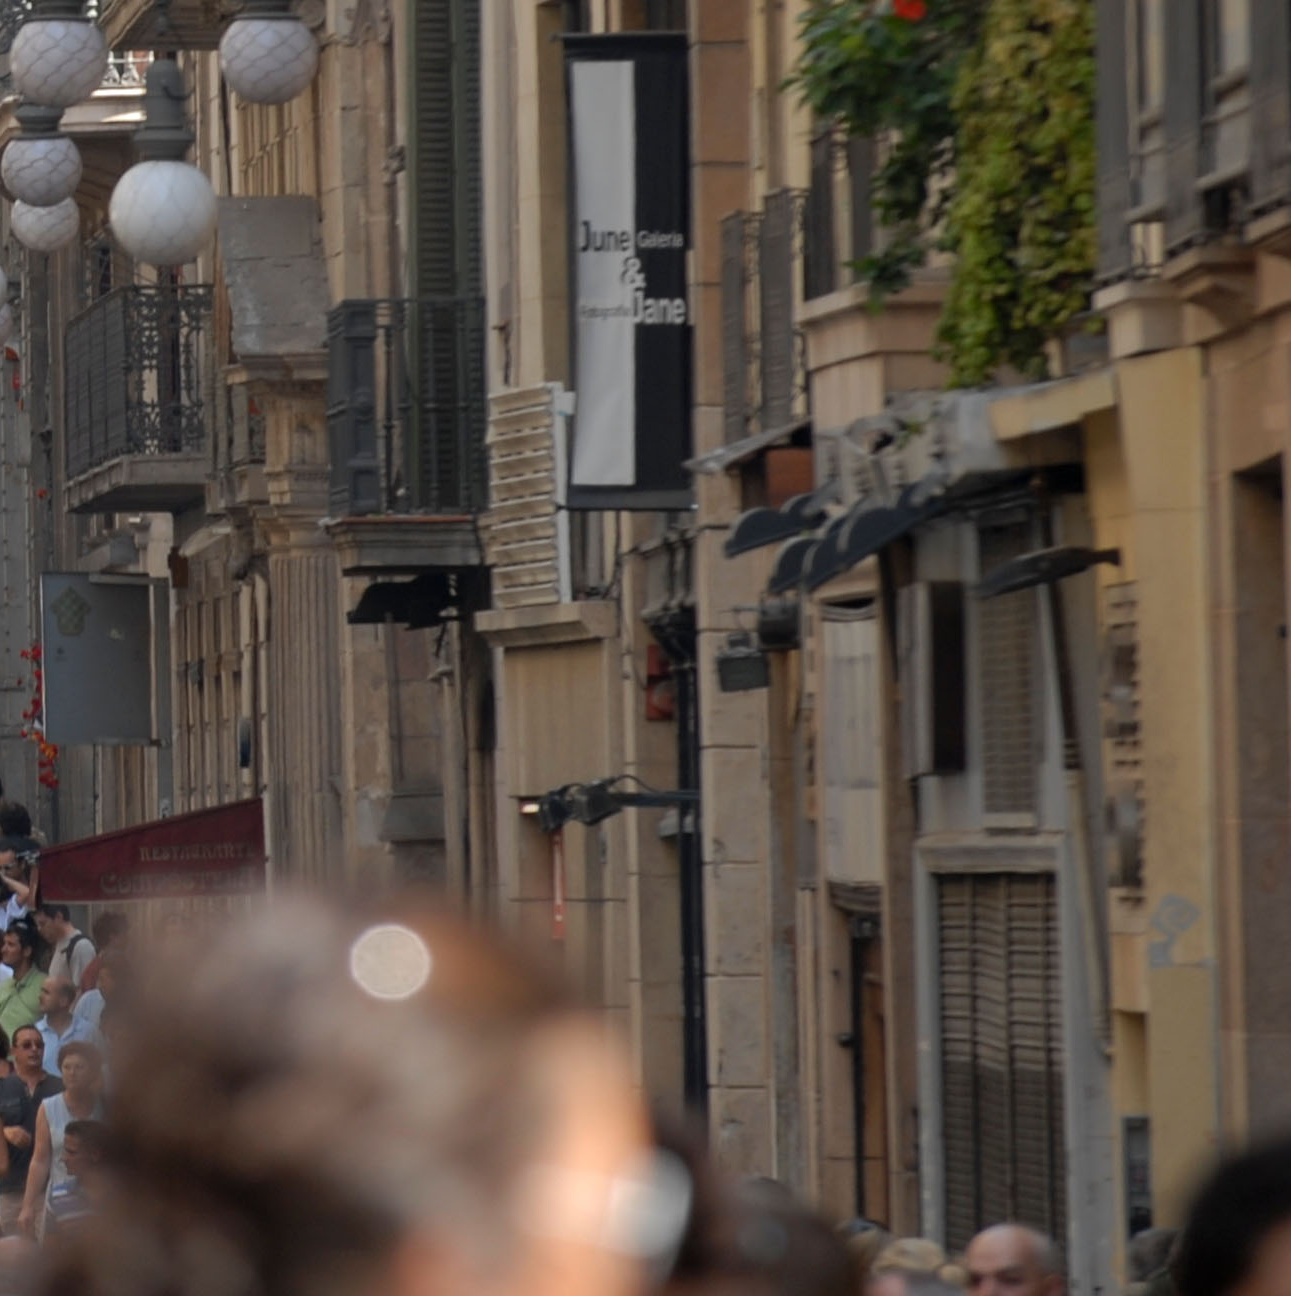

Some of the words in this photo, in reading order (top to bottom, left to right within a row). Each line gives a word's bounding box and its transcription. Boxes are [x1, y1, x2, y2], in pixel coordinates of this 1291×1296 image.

[580, 220, 630, 252] June
[620, 256, 646, 289] &
[633, 290, 686, 324] Jane
